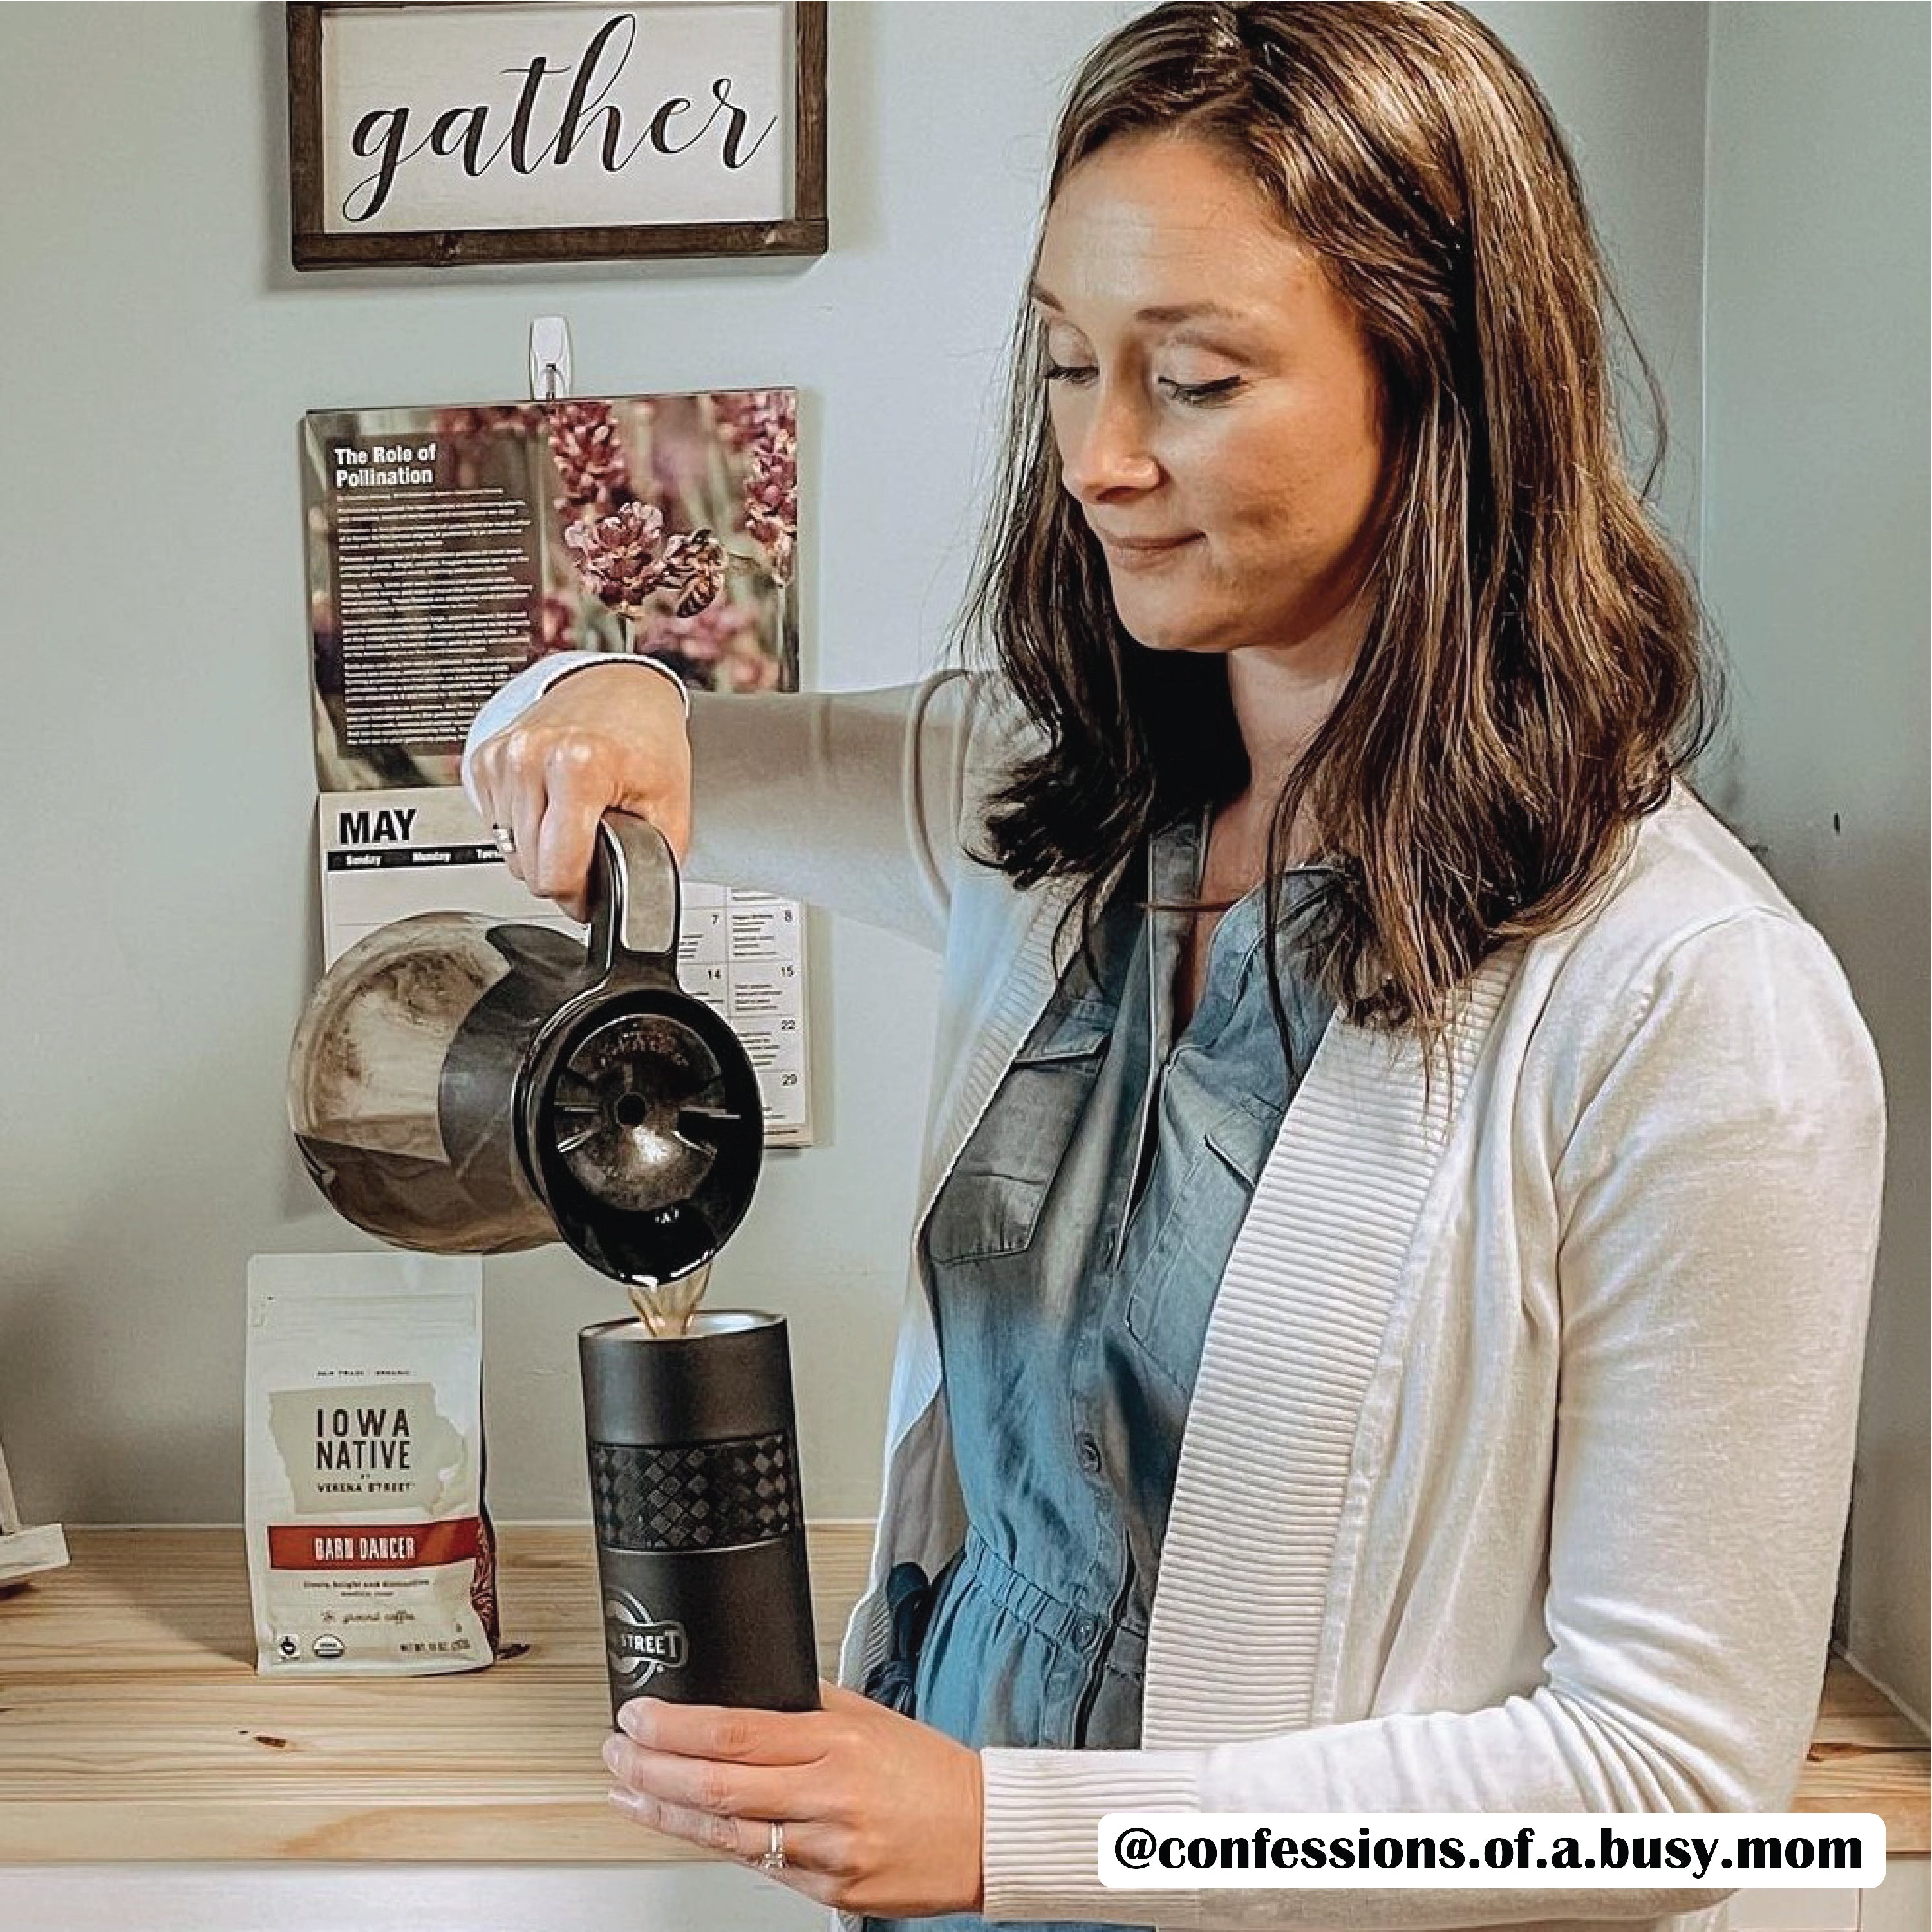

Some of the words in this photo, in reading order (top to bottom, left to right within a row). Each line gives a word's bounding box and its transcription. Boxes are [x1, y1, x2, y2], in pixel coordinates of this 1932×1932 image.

[342, 13, 778, 222] gather
[335, 447, 368, 465] The
[373, 444, 413, 464] Role
[418, 442, 436, 462] of
[337, 466, 433, 488] Pollination
[340, 809, 417, 844] MAY
[346, 855, 381, 866] Sunday
[413, 852, 451, 863] Monday
[711, 914, 720, 924] 7
[708, 968, 722, 979] 14
[781, 966, 794, 977] 15
[781, 1019, 796, 1030] 22
[782, 1073, 798, 1086] 29
[317, 1409, 411, 1438] IOWA
[317, 1440, 411, 1470] NATIVE
[317, 1483, 362, 1492] VERENA
[368, 1483, 411, 1492] STREET
[315, 1537, 353, 1561] BARN
[359, 1537, 416, 1560] DANCER
